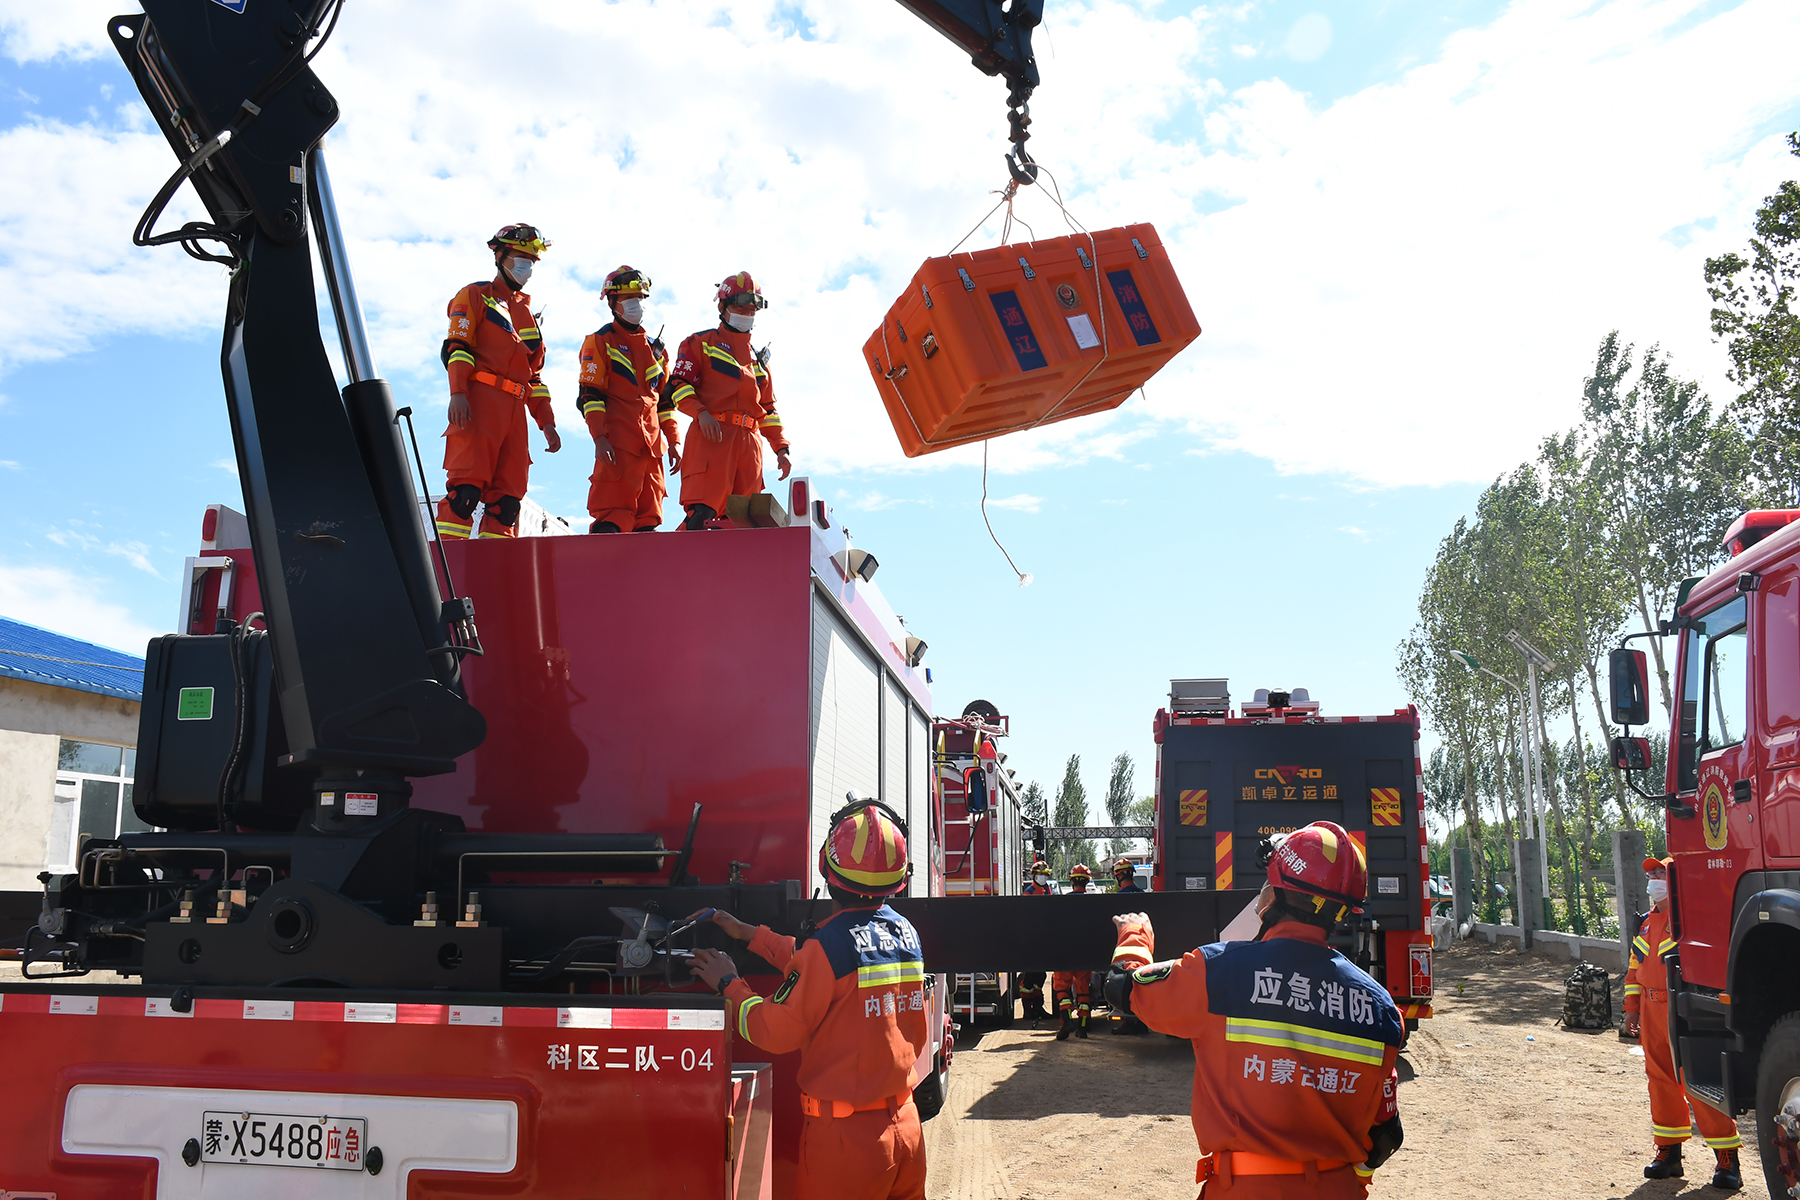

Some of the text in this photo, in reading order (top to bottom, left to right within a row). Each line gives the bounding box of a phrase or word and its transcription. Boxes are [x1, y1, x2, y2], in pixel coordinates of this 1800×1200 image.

[1118, 284, 1150, 332] 消防
[1002, 307, 1036, 354] 通辽
[1276, 843, 1308, 875] 古消防
[849, 919, 920, 953] 应急消
[1250, 967, 1375, 1026] 应急消防
[547, 1043, 714, 1072] 科区二队-04
[1243, 1054, 1362, 1094] 内蒙古通辽
